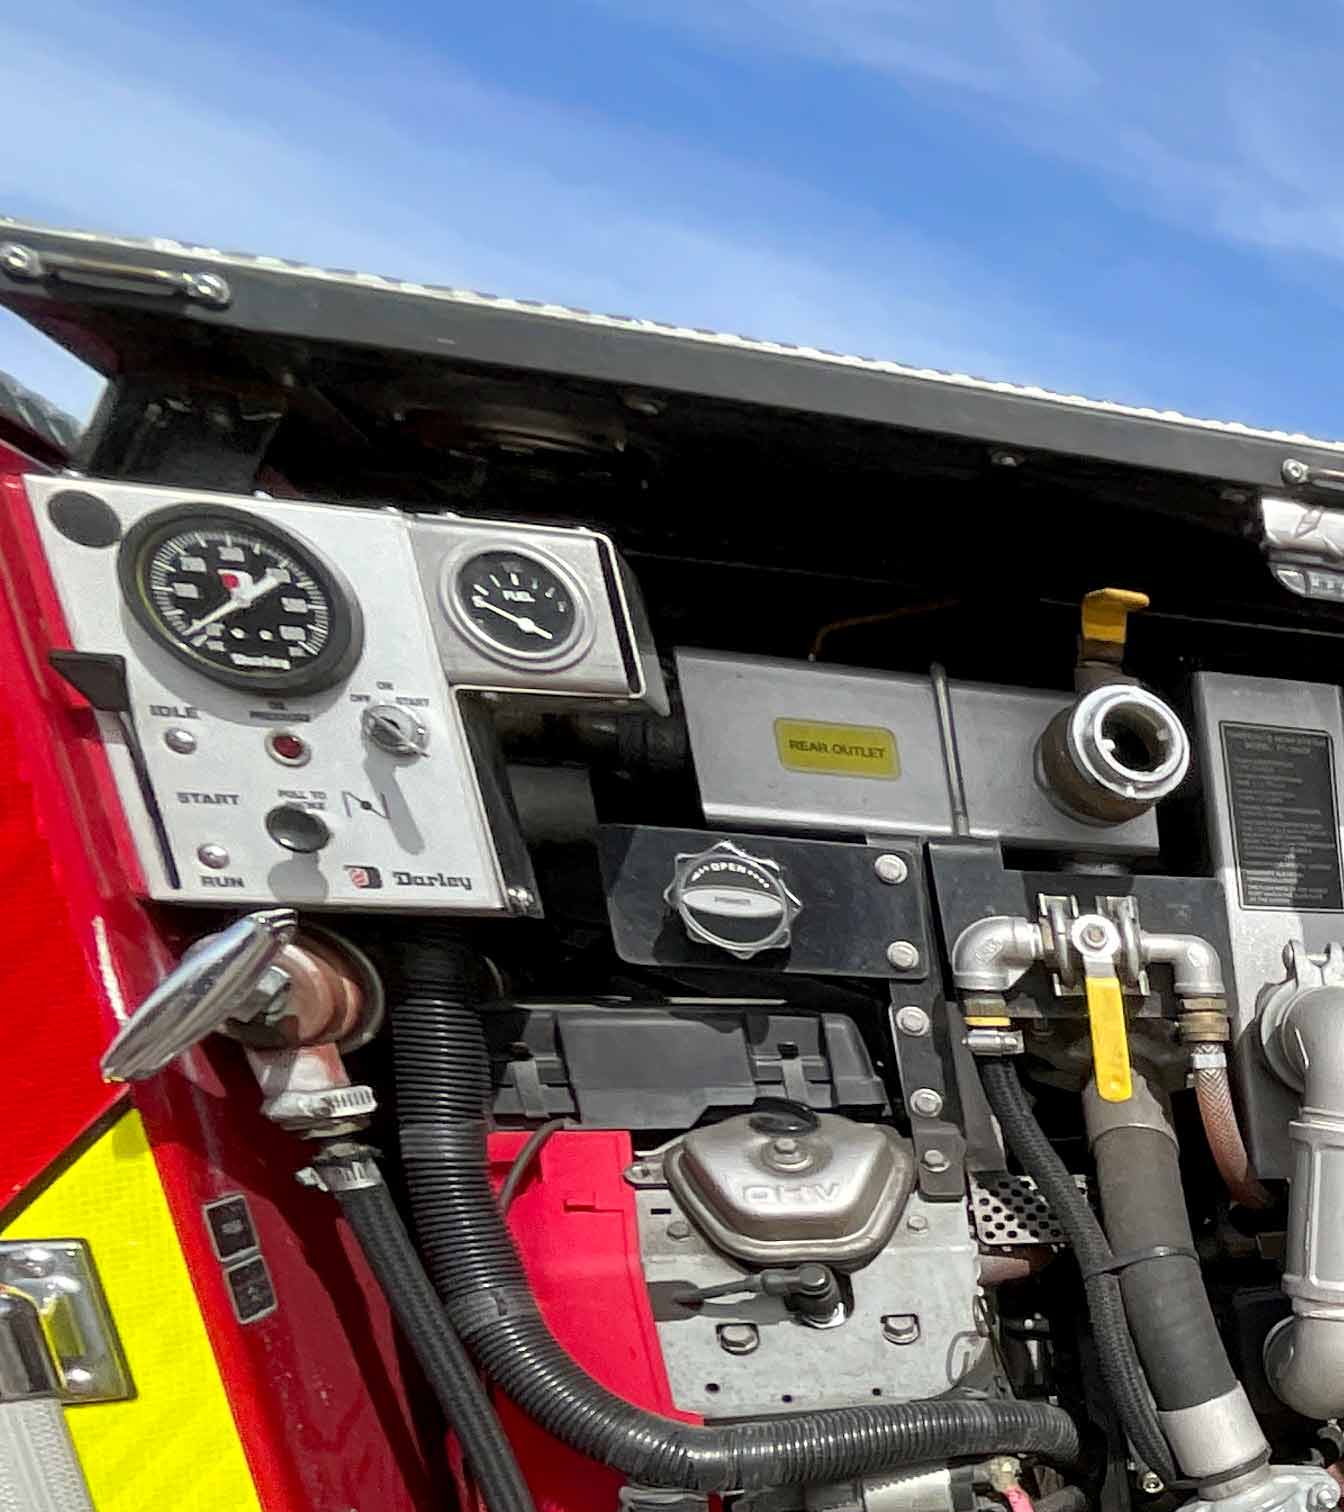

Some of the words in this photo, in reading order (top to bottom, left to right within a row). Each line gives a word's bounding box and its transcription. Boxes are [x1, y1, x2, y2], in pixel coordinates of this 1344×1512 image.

[502, 589, 536, 603] FUEL
[150, 704, 200, 720] IDLE
[788, 739, 829, 754] REAR
[832, 743, 886, 759] OUTLET
[176, 792, 240, 806] START
[309, 791, 327, 801] TO
[710, 862, 747, 875] OPEN
[200, 875, 245, 889] RUN
[392, 871, 473, 891] Darley
[741, 1183, 841, 1204] OHV
